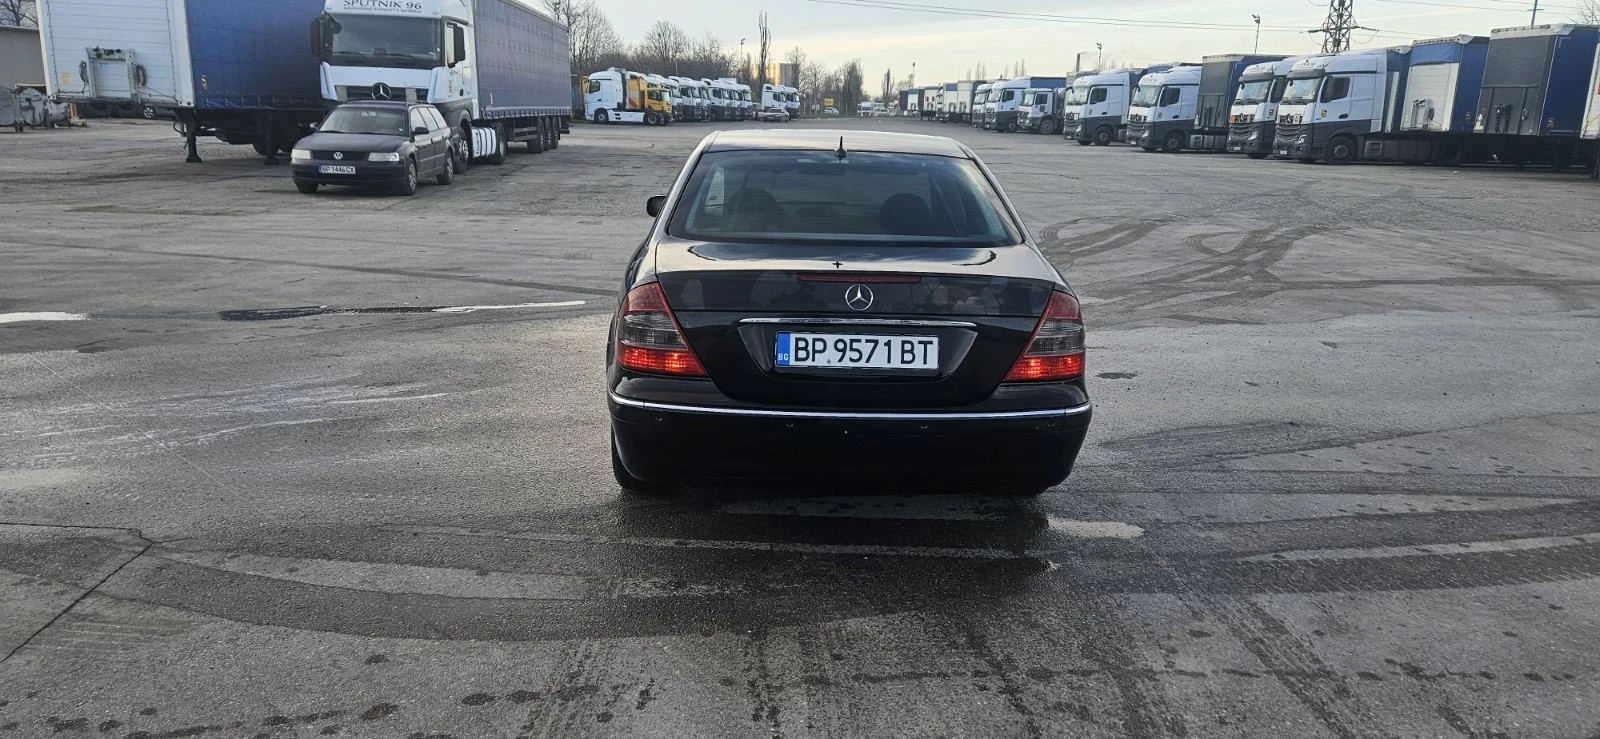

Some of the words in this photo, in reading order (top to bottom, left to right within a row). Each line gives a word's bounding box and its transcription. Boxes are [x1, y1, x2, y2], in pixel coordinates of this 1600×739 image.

[344, 0, 401, 8] SPUTNIK
[406, 2, 422, 10] 96
[793, 337, 828, 363] BP
[833, 338, 892, 364] 9571
[900, 340, 934, 365] BT
[777, 353, 789, 361] BG
